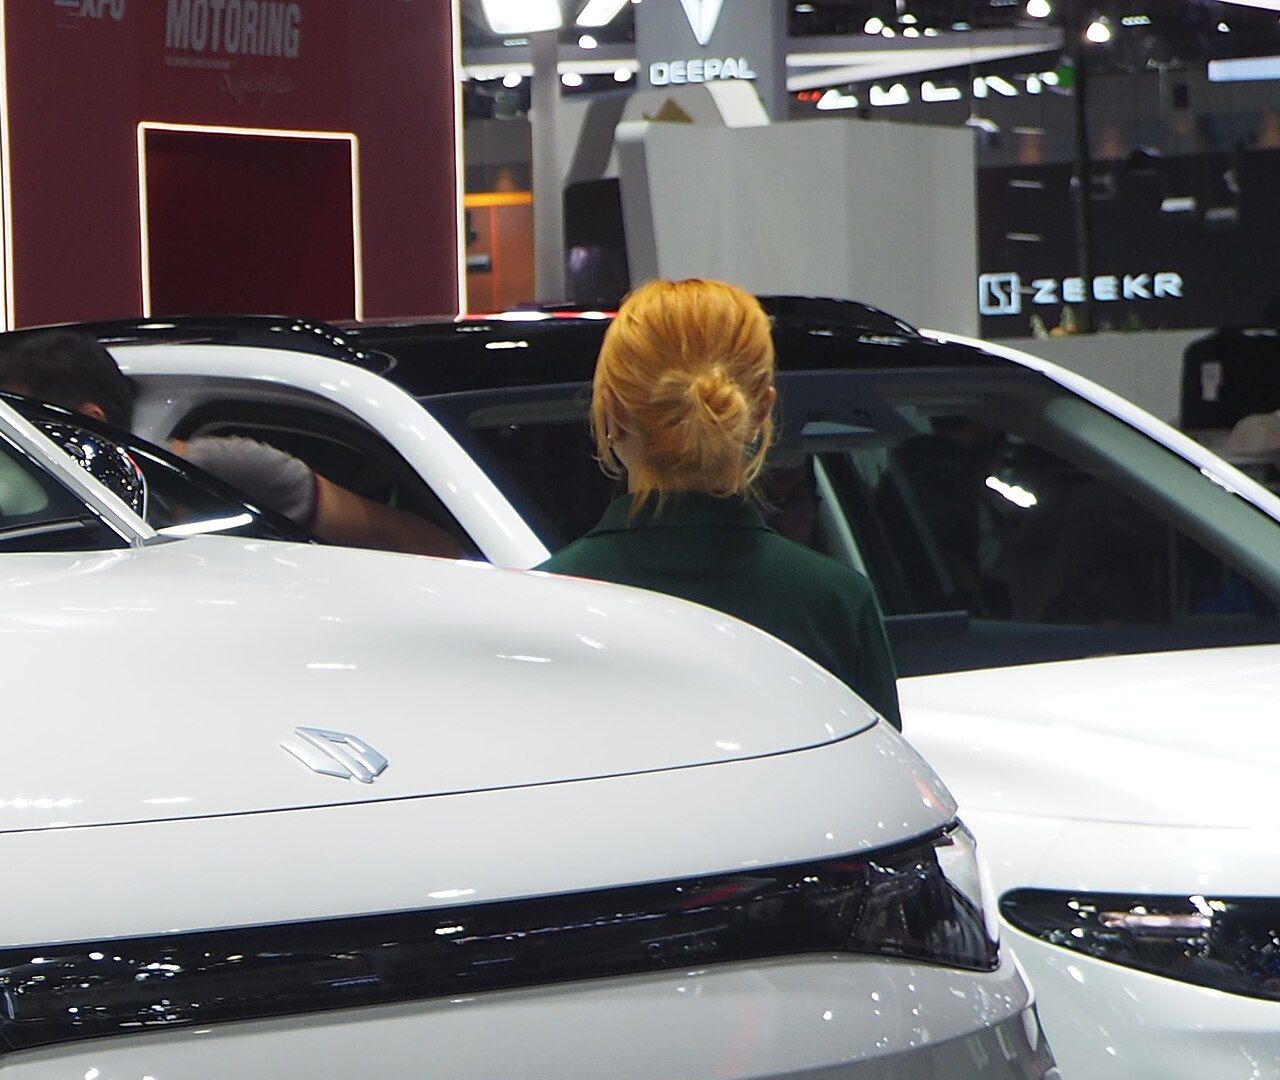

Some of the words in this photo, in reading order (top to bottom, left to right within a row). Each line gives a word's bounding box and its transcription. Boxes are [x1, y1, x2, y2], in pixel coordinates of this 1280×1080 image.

[165, 0, 301, 58] MOTORING
[649, 57, 759, 86] DEEPAL
[1032, 272, 1183, 304] ZEEKR
